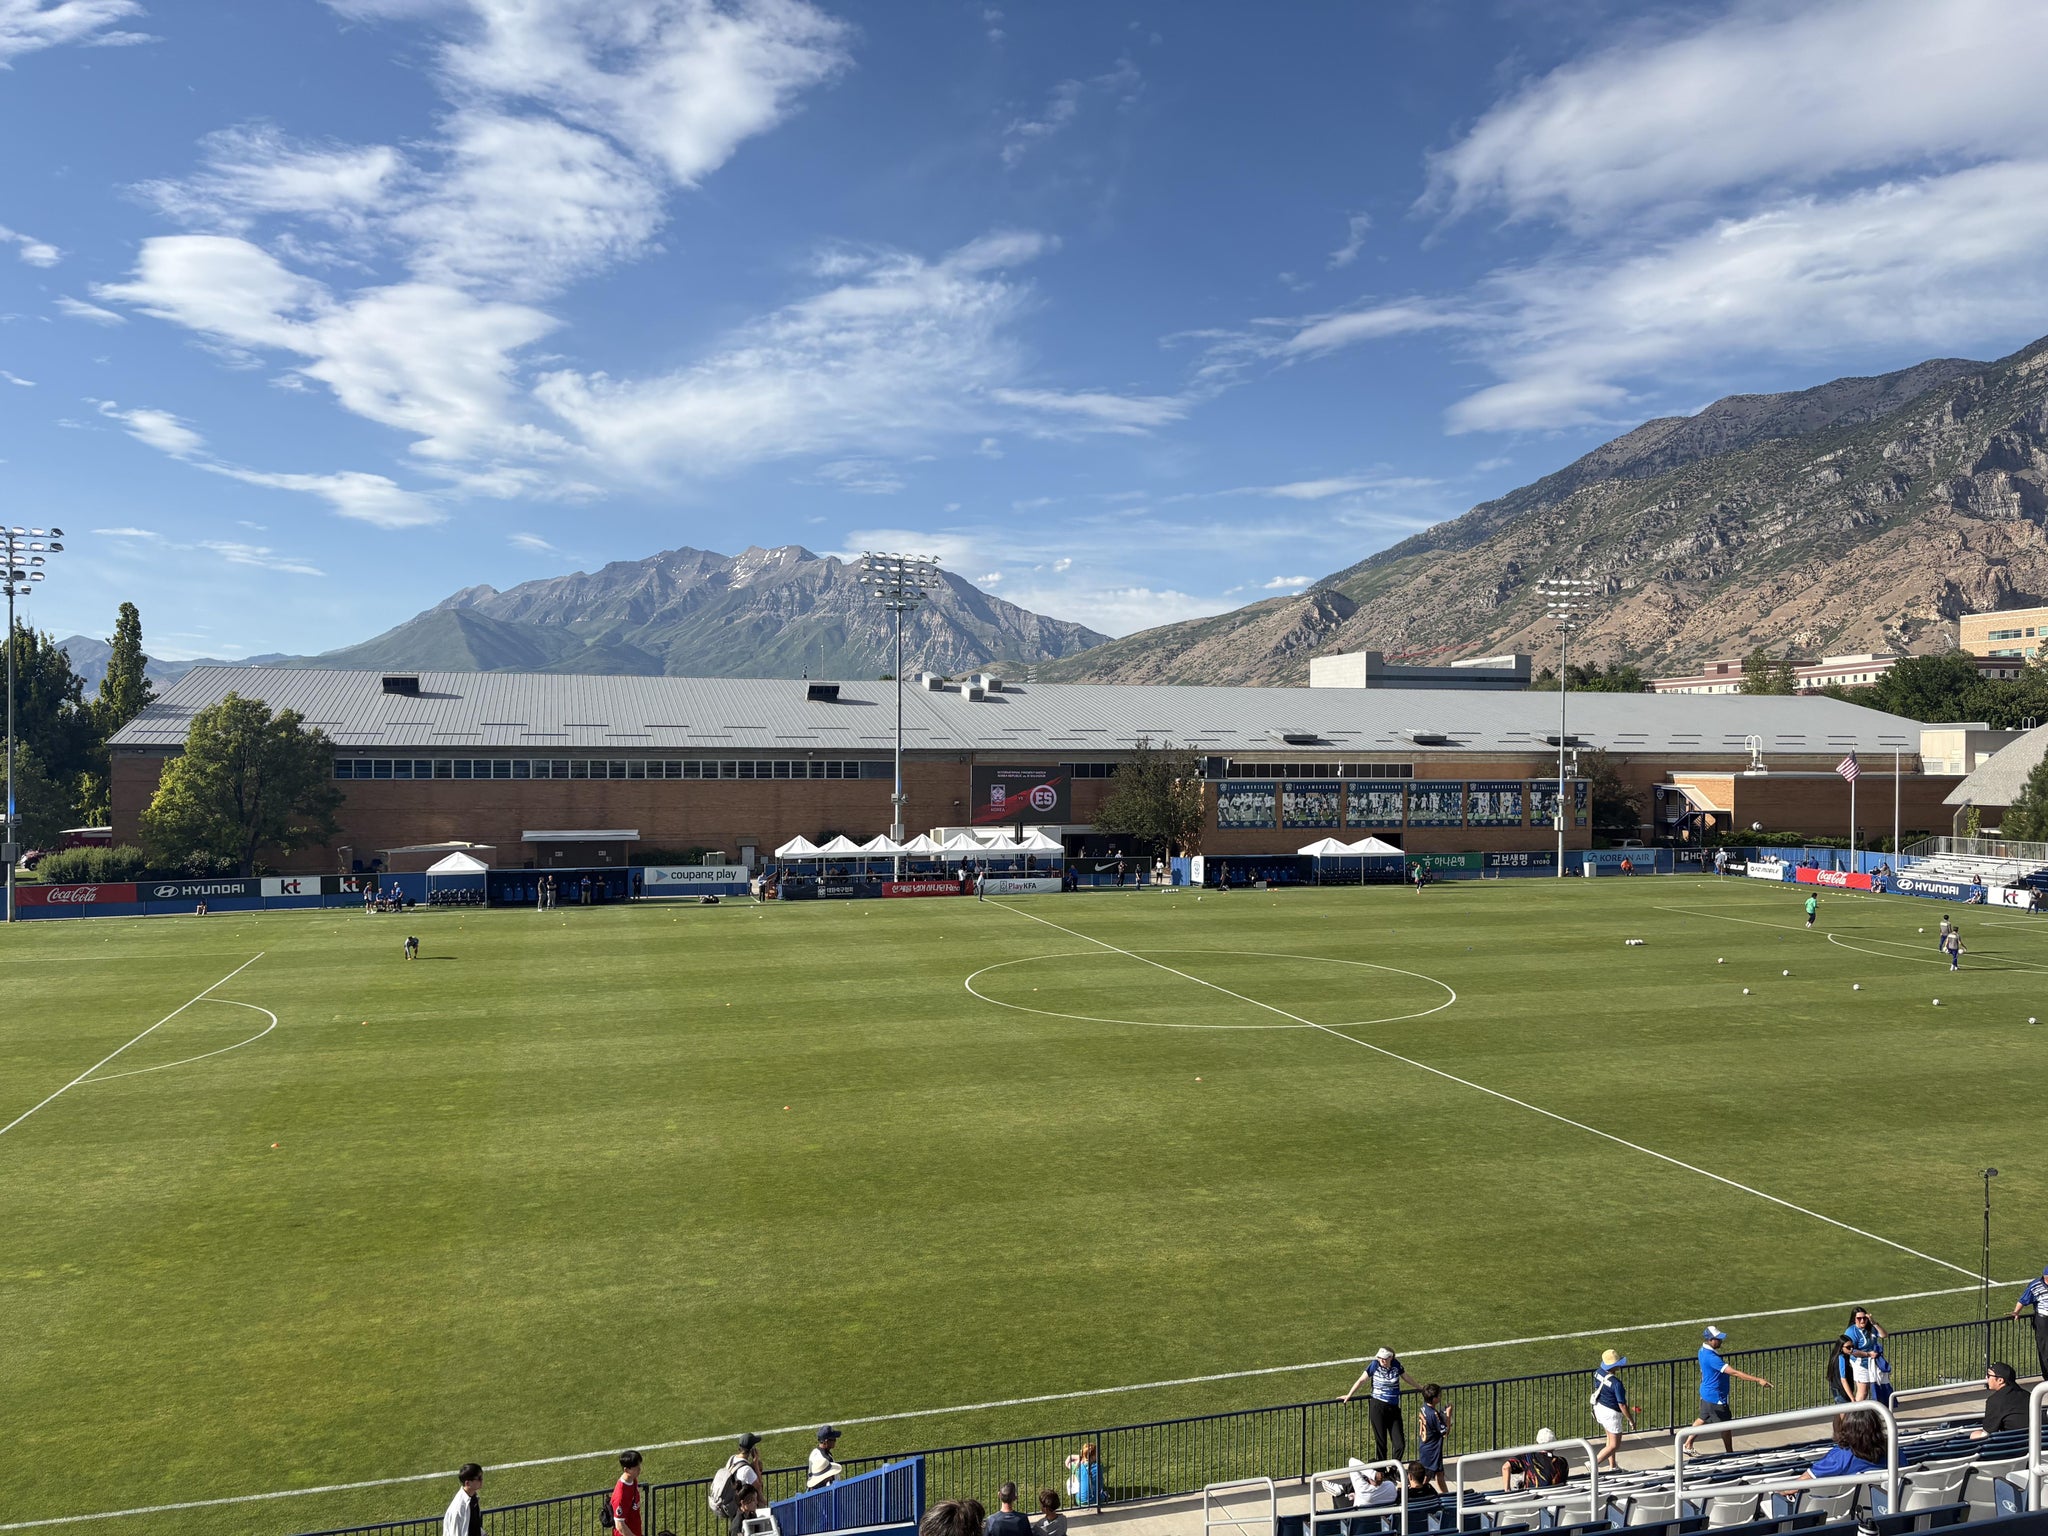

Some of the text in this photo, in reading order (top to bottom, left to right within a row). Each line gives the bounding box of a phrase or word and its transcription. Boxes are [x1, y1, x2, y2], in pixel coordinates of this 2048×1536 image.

[1035, 791, 1052, 805] ES
[1434, 856, 1466, 867] 하나은행
[1491, 853, 1528, 866] 교보생명
[1636, 853, 1650, 862] AIR
[671, 868, 737, 881] coupang play
[182, 883, 245, 896] HYUNDAI
[281, 879, 301, 895] kt
[339, 876, 360, 893] kt
[1915, 881, 1959, 896] HYUNDAI
[2002, 888, 2019, 905] kt
